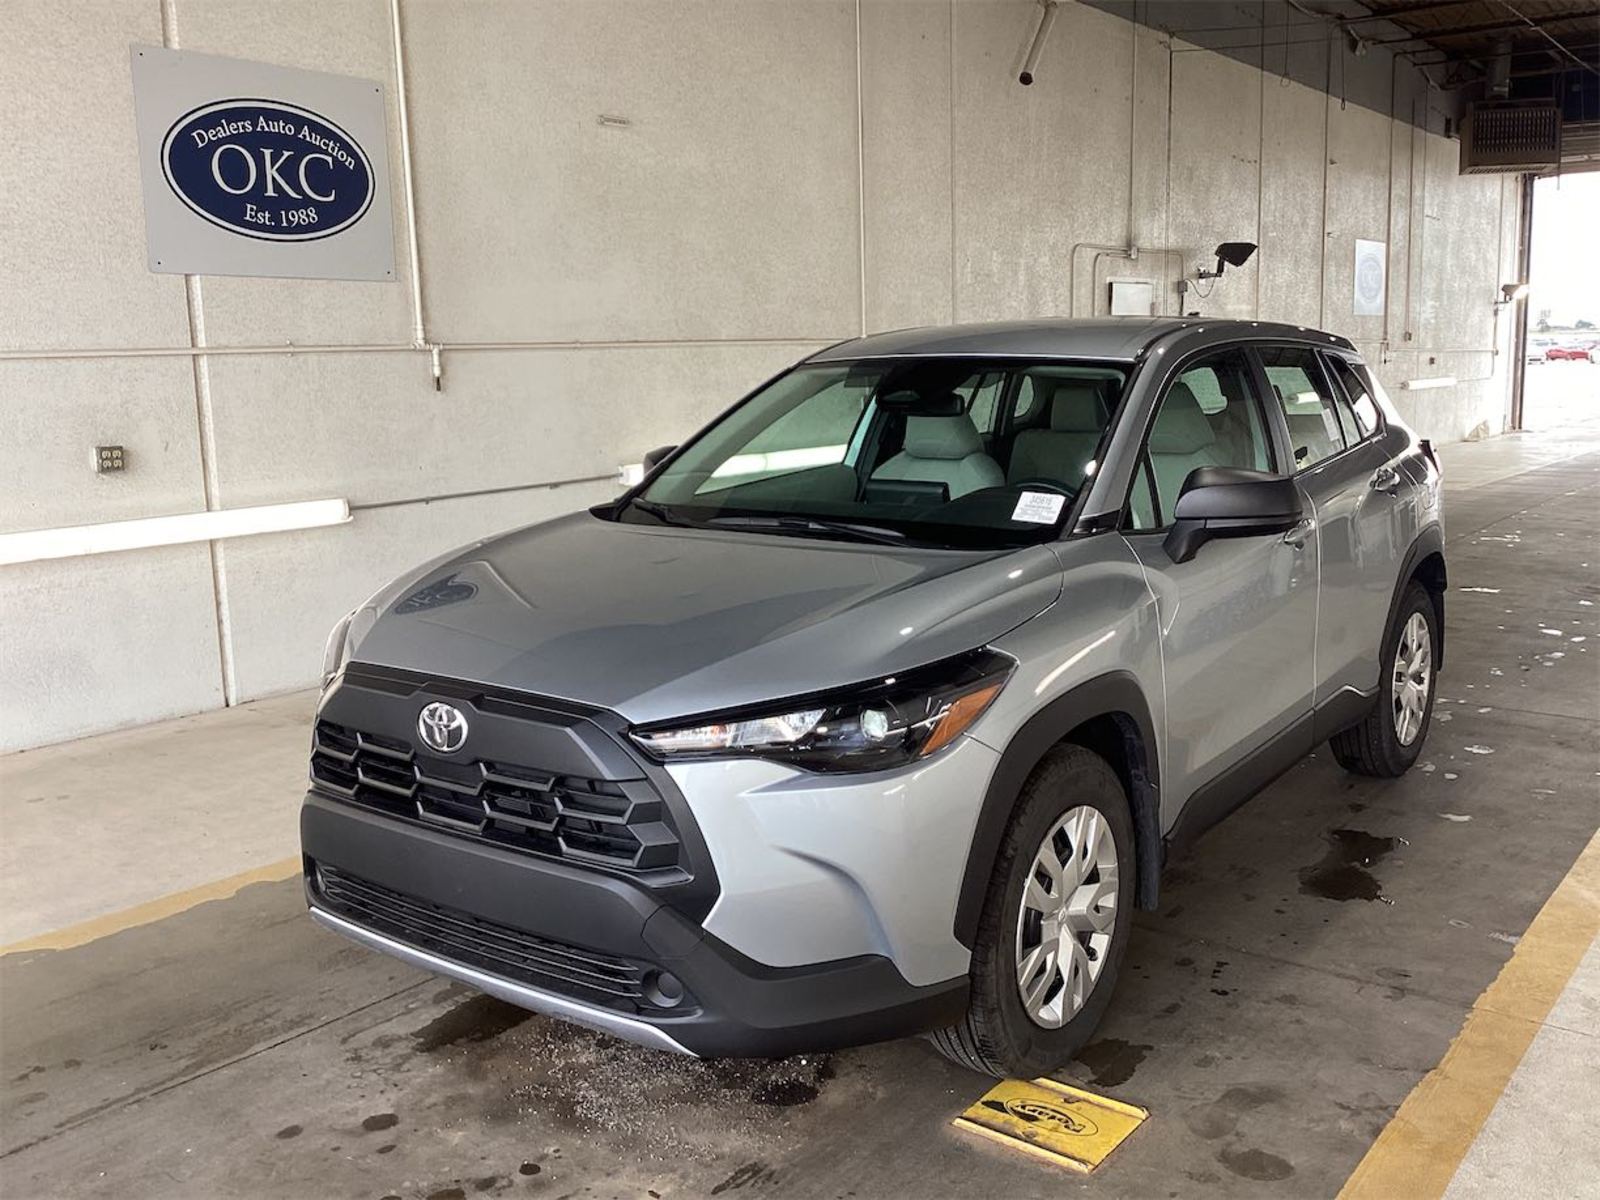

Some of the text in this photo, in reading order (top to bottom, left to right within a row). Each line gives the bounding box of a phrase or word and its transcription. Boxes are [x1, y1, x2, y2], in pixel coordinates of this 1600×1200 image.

[191, 115, 356, 170] Dealers Auto Auction
[211, 143, 336, 203] OKC
[243, 203, 319, 227] Est. 1988
[1014, 1103, 1086, 1133] Rotary
